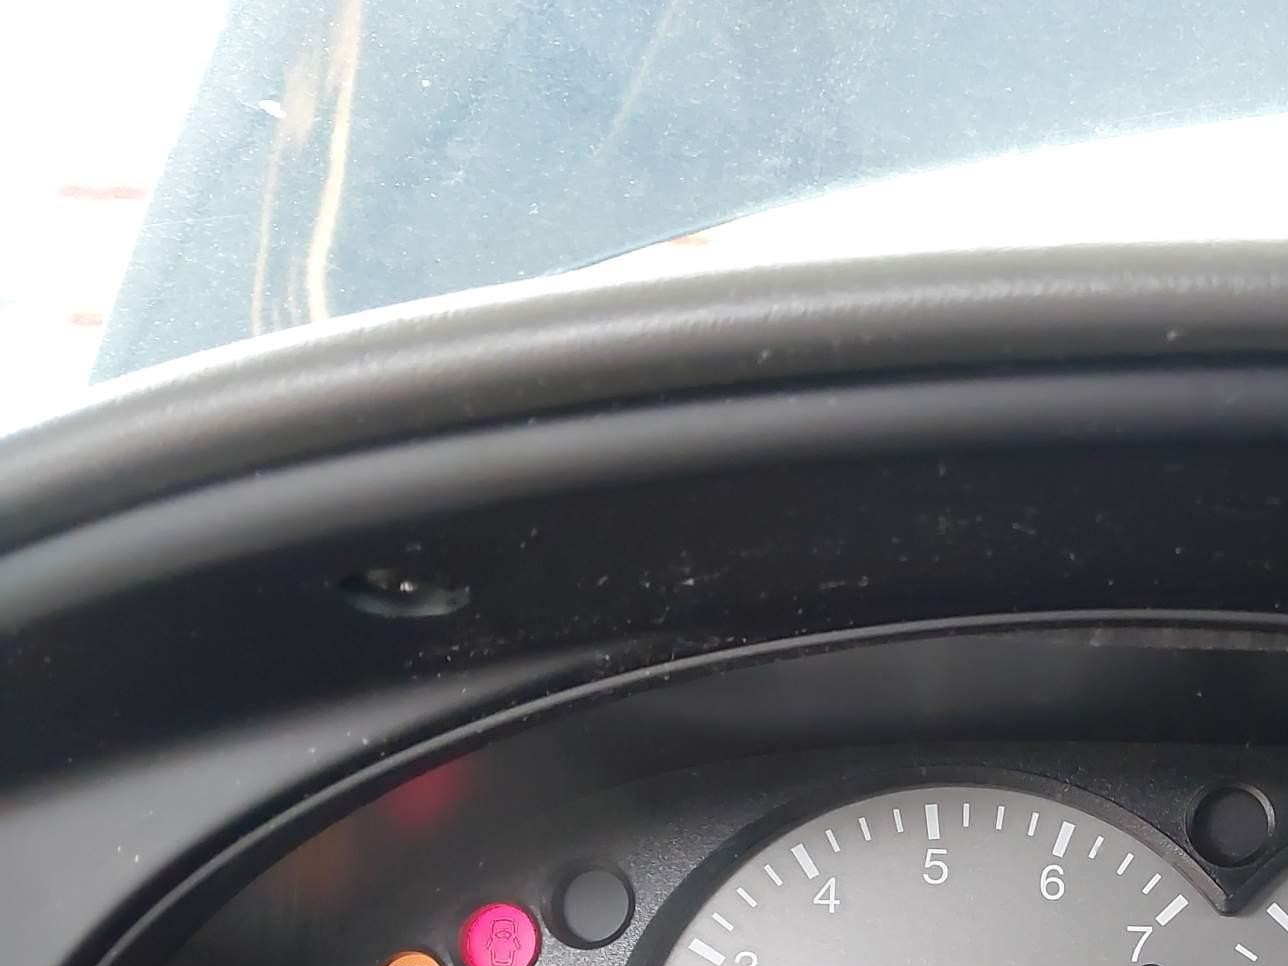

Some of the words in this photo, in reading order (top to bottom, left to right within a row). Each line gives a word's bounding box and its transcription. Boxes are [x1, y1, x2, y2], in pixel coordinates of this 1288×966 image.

[923, 849, 948, 884] 5
[1040, 865, 1065, 901] 6
[813, 877, 840, 913] 4
[1127, 926, 1153, 962] 7
